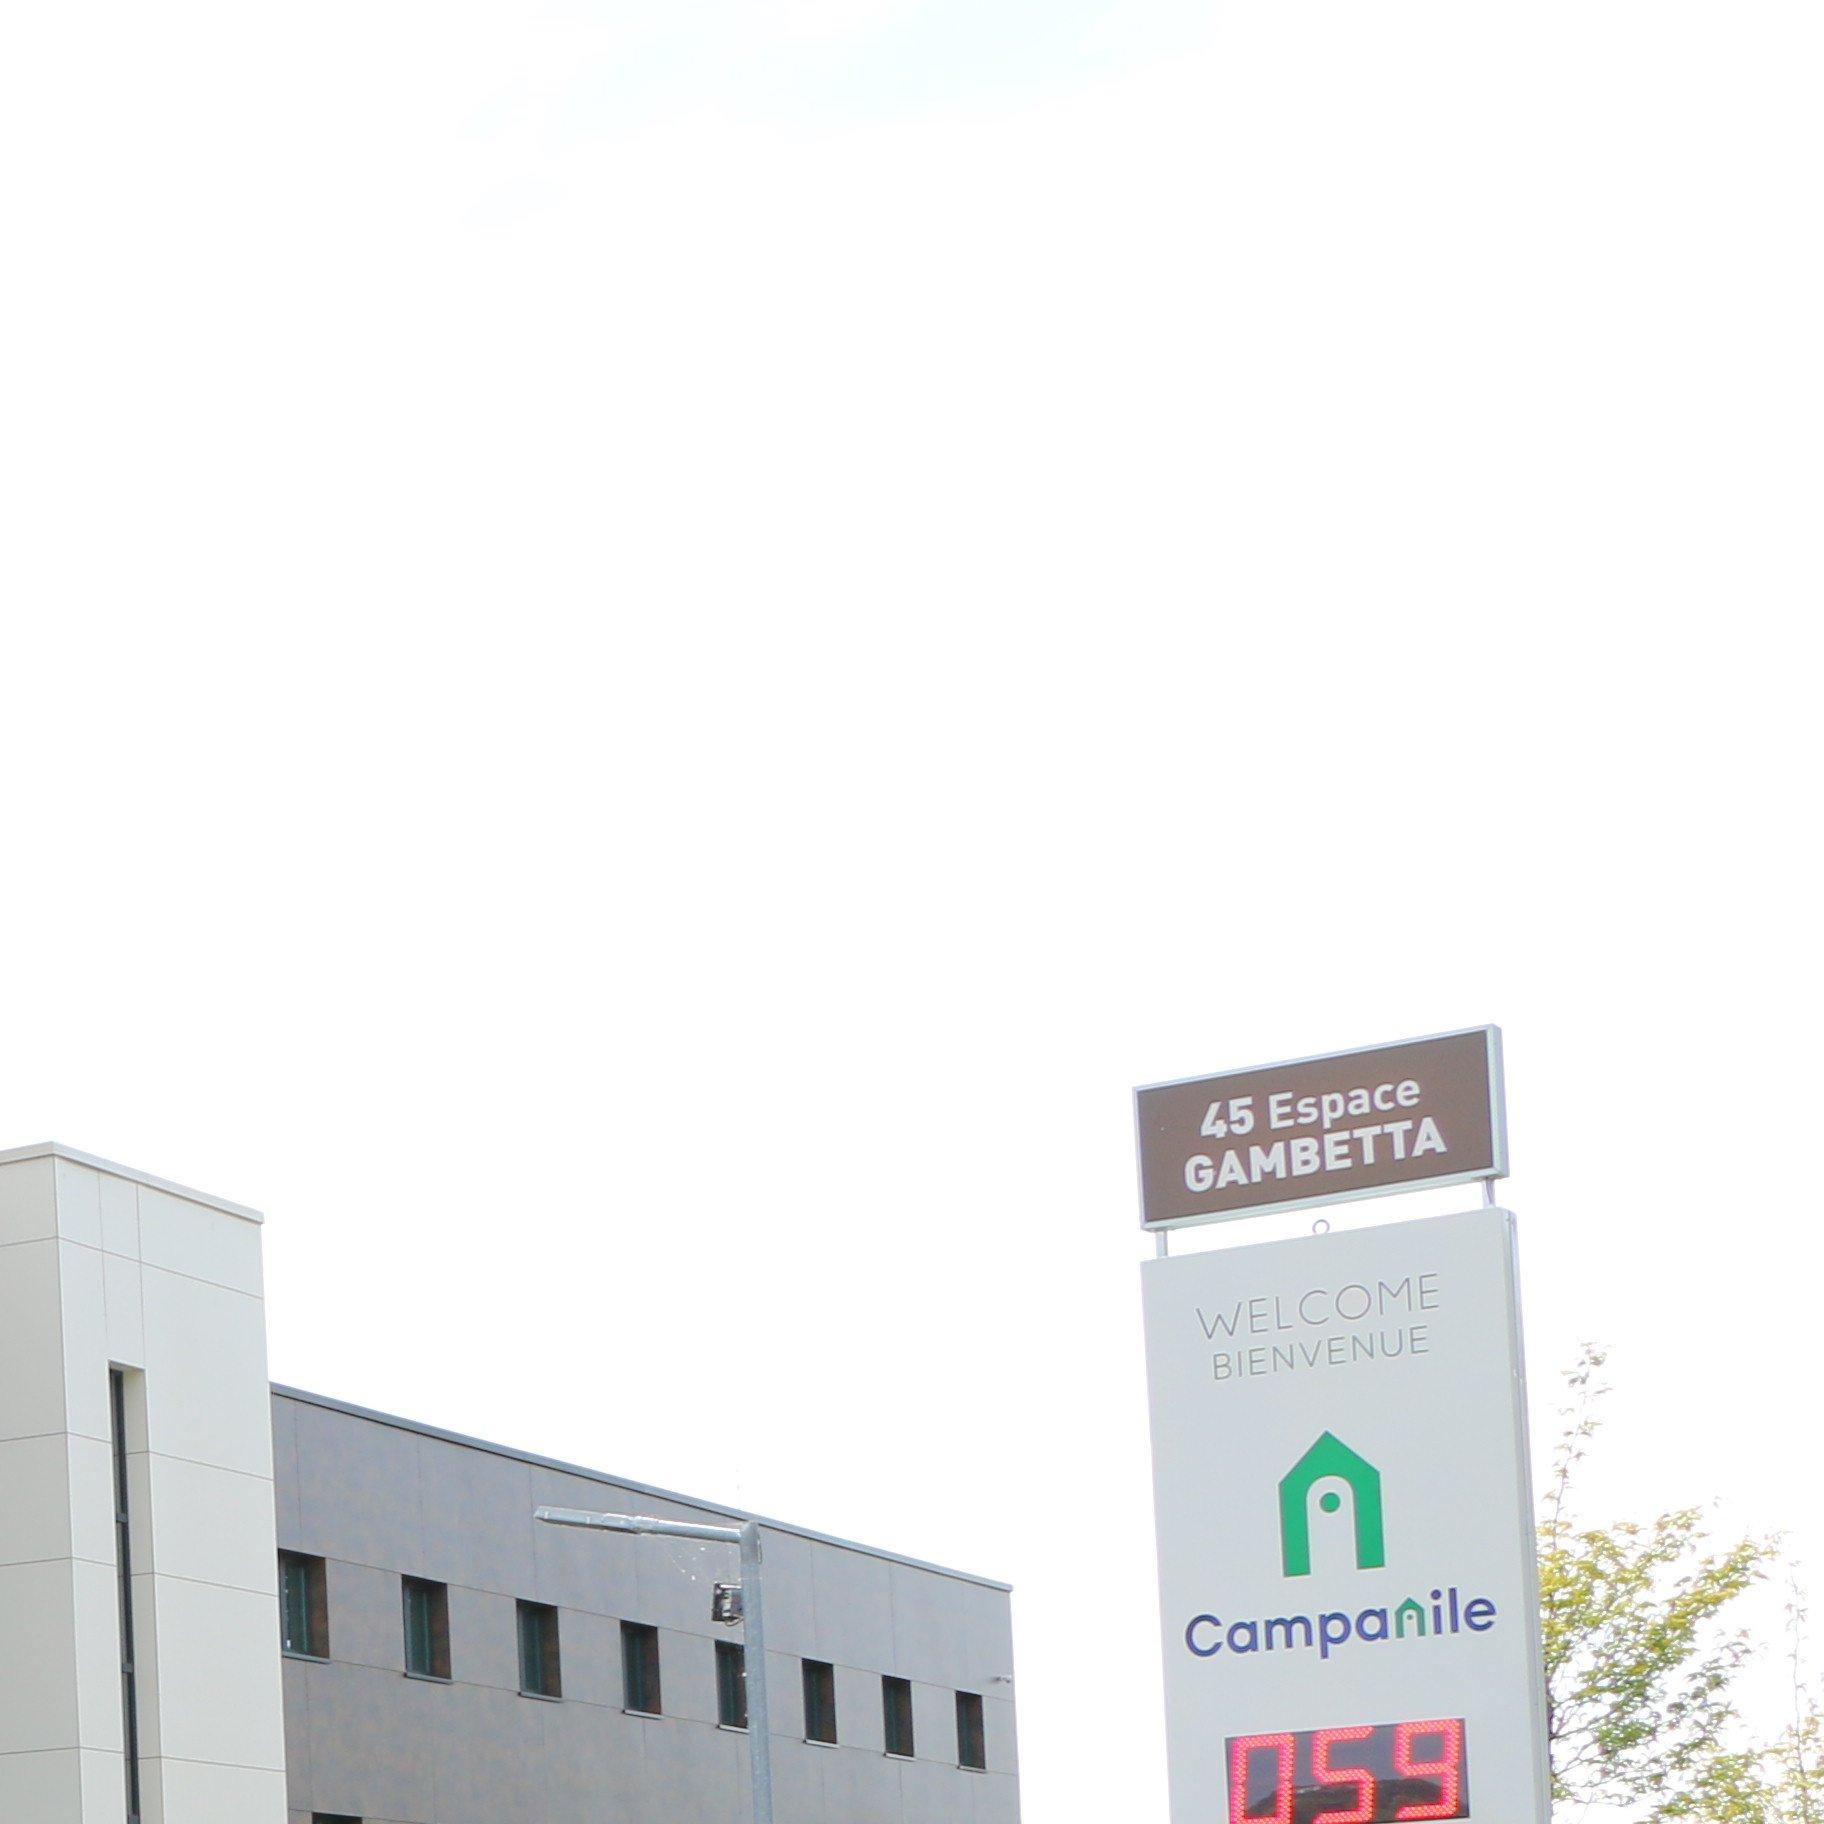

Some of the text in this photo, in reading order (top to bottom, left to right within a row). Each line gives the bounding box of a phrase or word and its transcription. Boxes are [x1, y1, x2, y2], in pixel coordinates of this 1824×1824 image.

[1201, 1077, 1421, 1138] 45 Espace
[1184, 1117, 1447, 1192] GAMBETTA
[1195, 1273, 1441, 1341] WELCOME
[1212, 1325, 1430, 1381] BIENVENUE
[1185, 1587, 1497, 1660] Campanile
